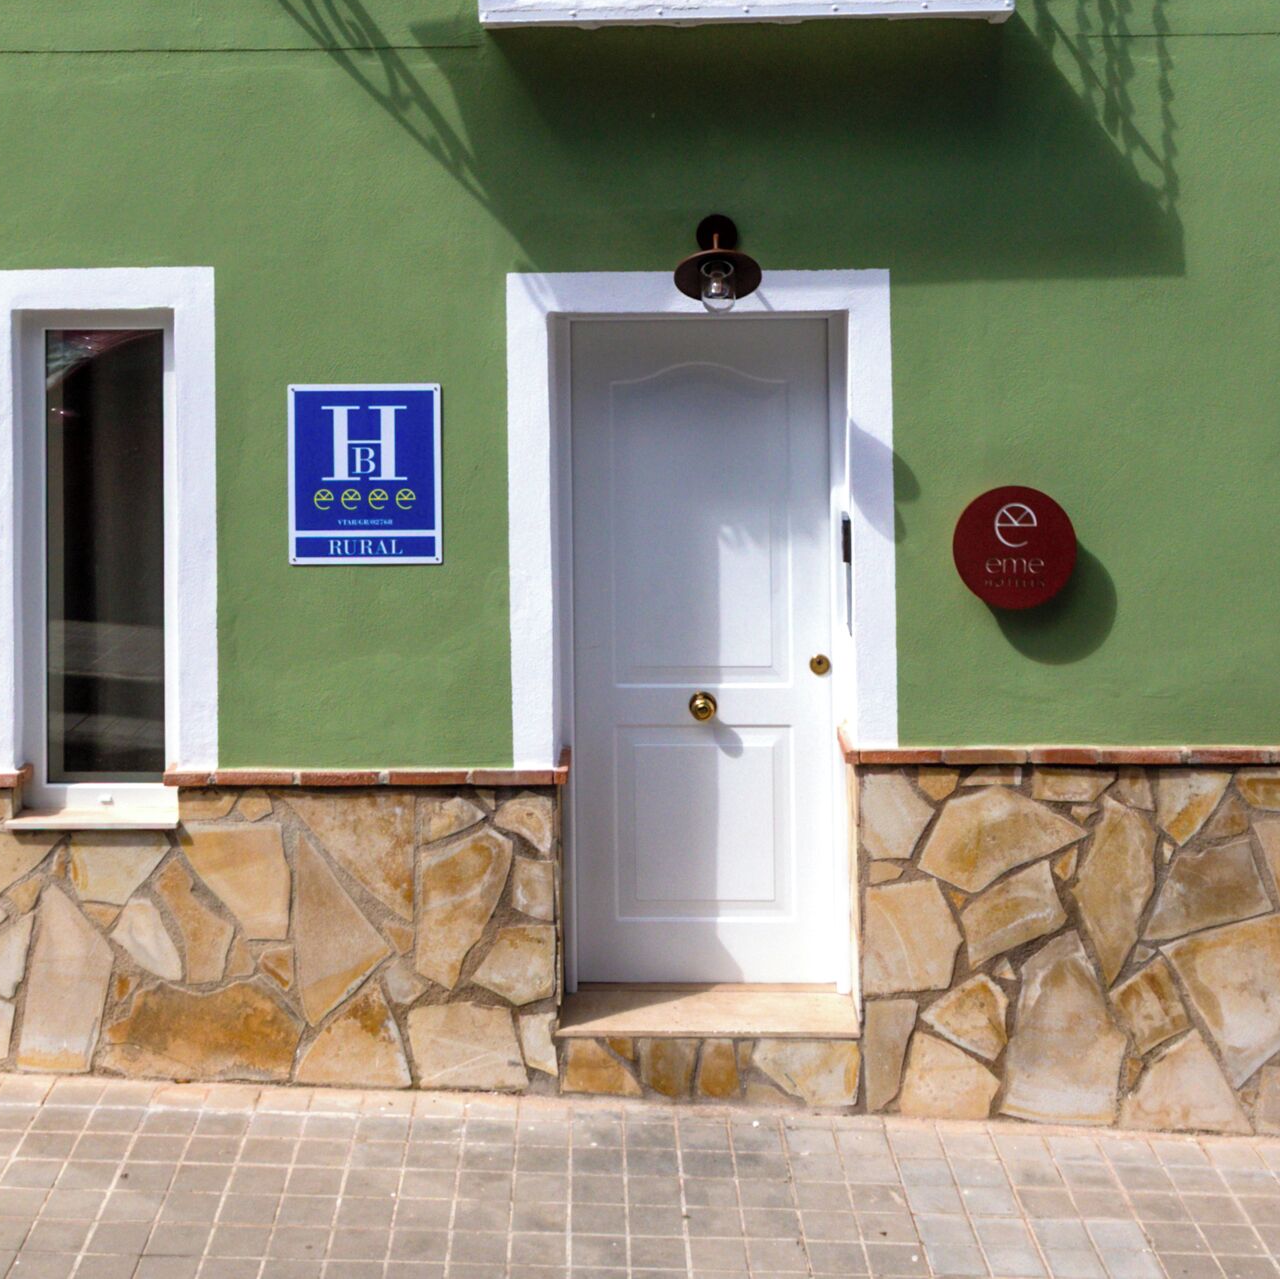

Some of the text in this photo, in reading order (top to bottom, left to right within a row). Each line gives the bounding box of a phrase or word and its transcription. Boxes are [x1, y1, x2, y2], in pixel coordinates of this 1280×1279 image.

[352, 447, 376, 474] B
[329, 539, 403, 555] RURAL
[985, 557, 1045, 574] eme
